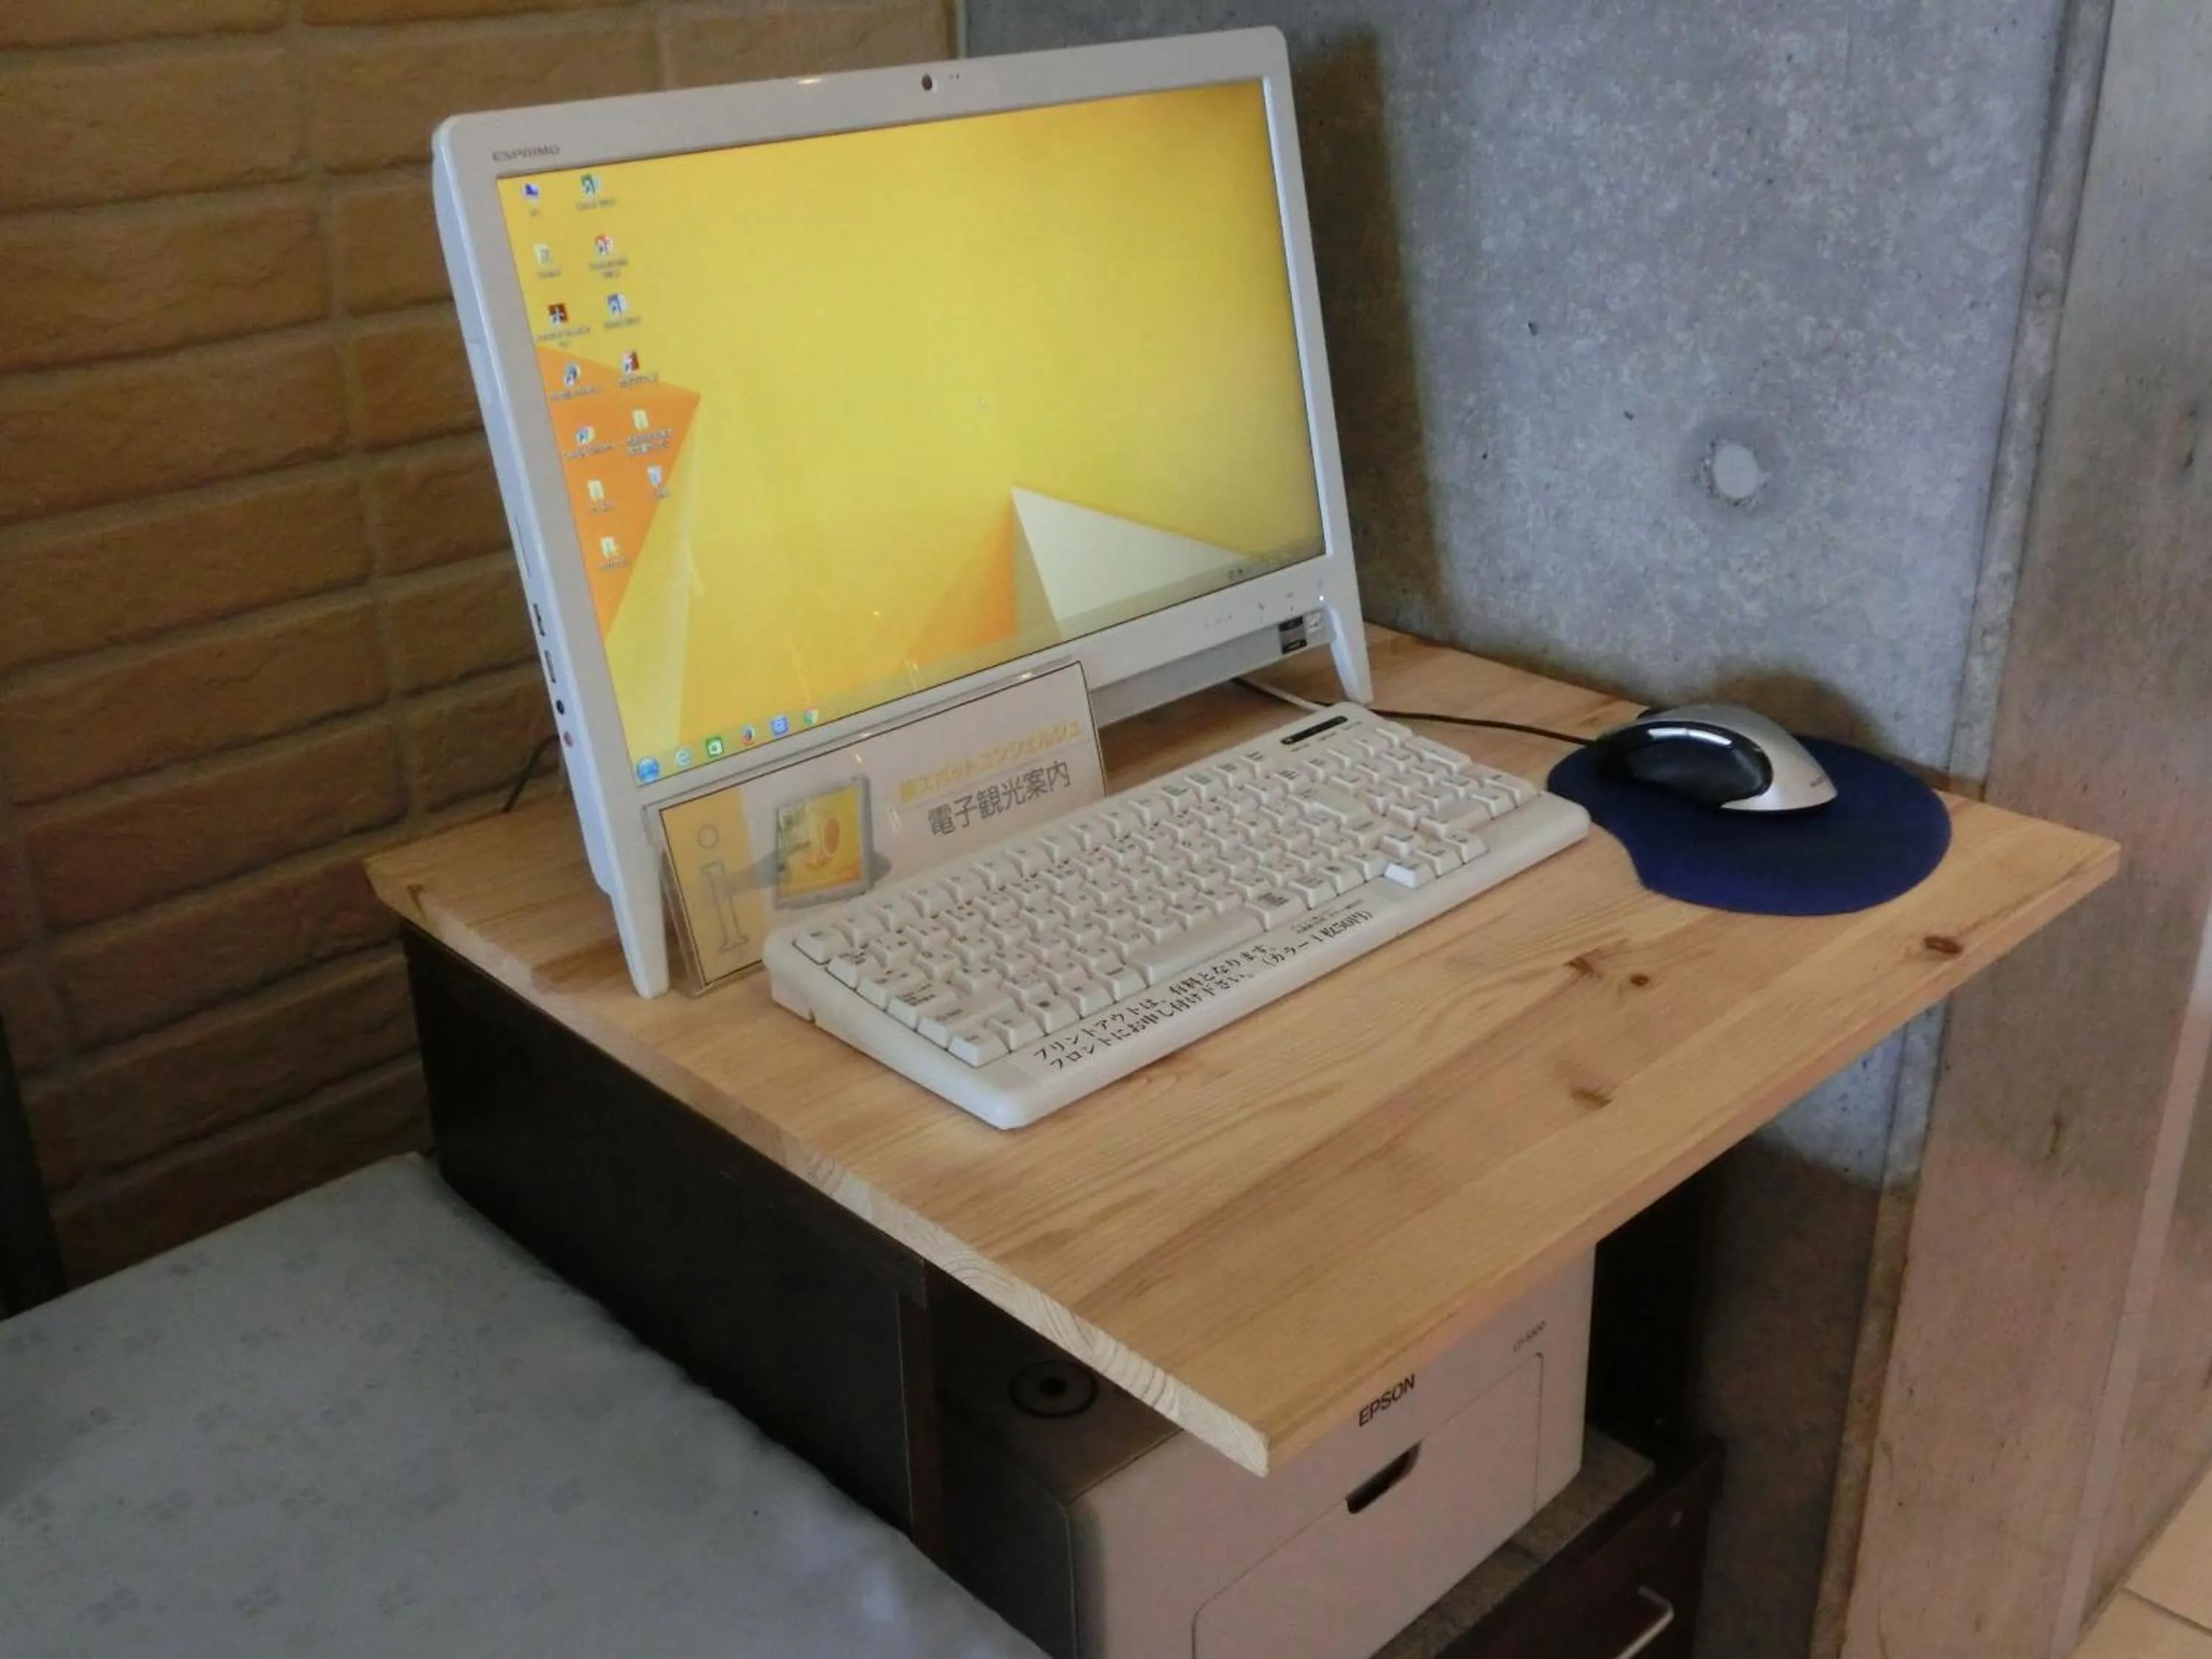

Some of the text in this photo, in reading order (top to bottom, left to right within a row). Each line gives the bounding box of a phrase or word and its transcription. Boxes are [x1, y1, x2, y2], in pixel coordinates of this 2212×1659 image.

[928, 760, 1071, 836] 電子観光案内
[1358, 1374, 1415, 1427] EPSON
